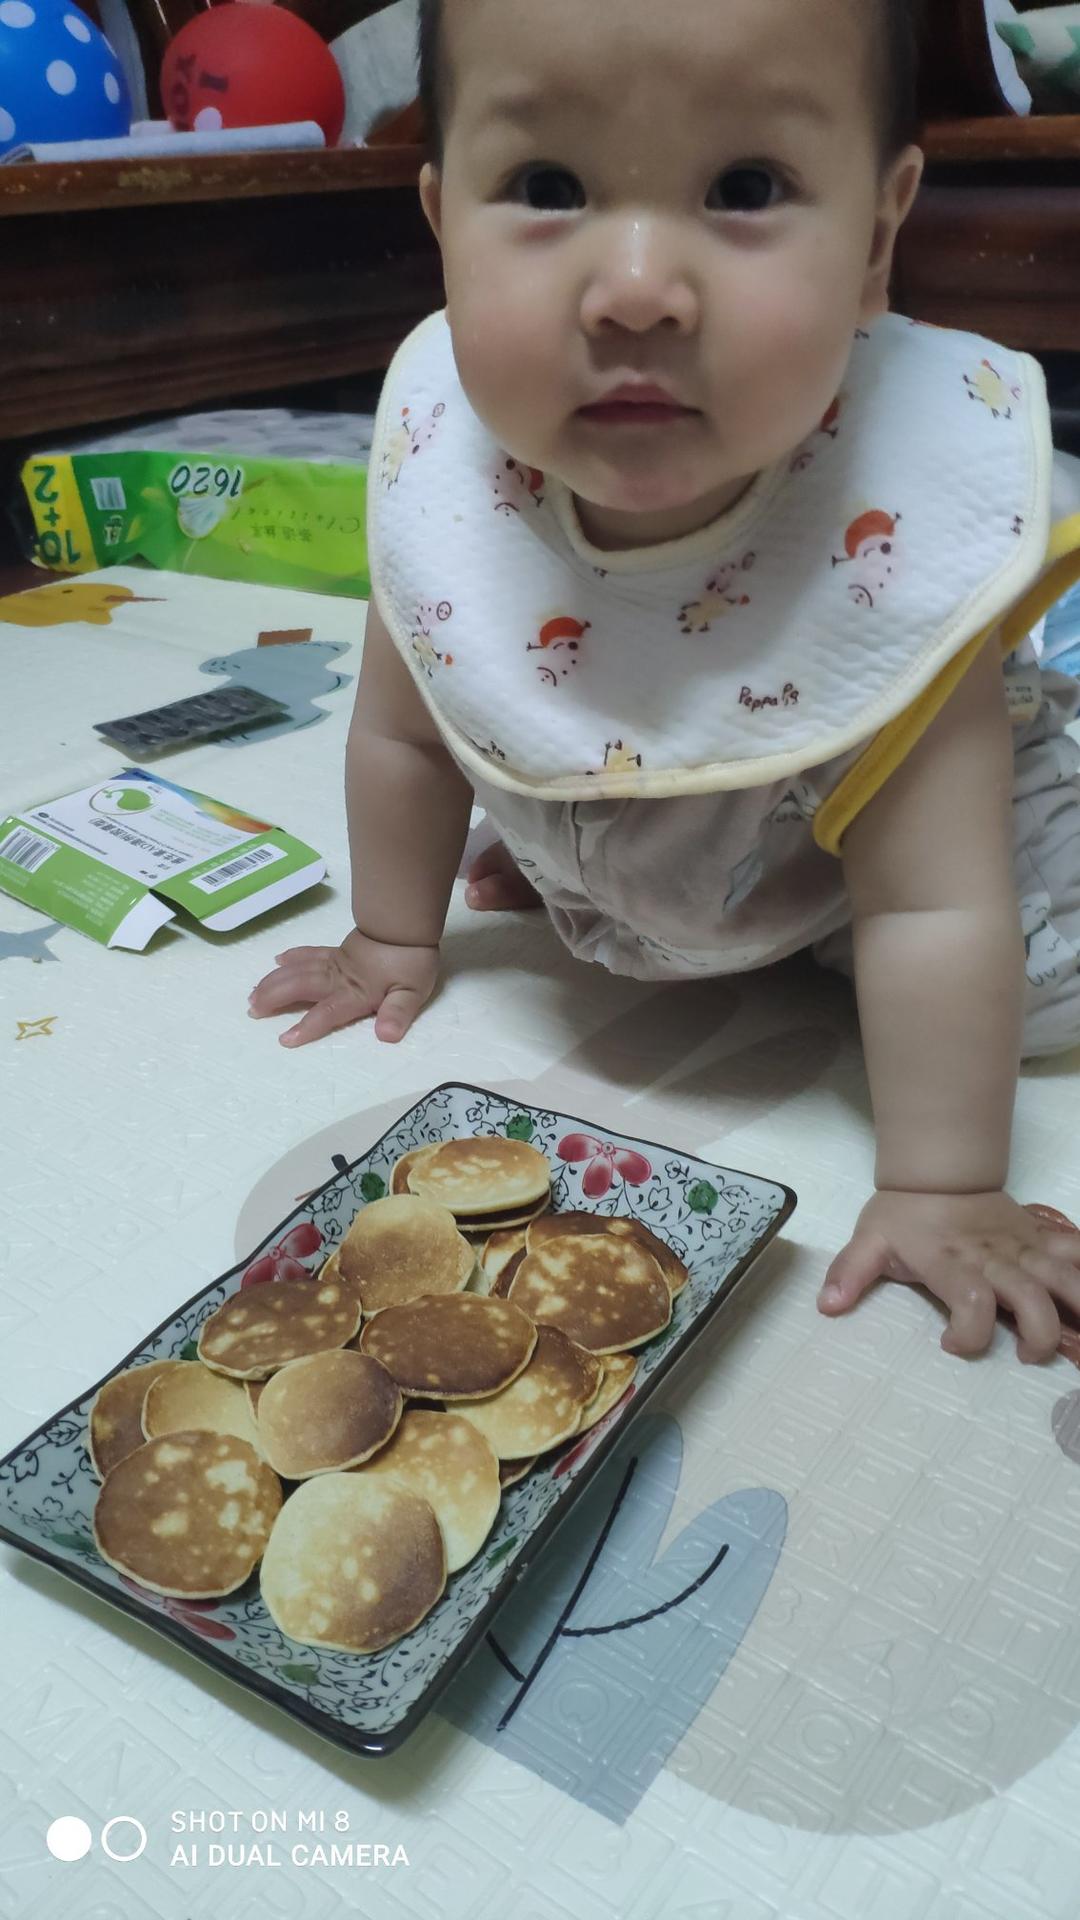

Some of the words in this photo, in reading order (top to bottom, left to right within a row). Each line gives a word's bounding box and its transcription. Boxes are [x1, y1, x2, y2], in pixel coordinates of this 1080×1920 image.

[171, 465, 242, 497] 1620
[738, 685, 778, 712] Peppa
[782, 682, 800, 706] Pig
